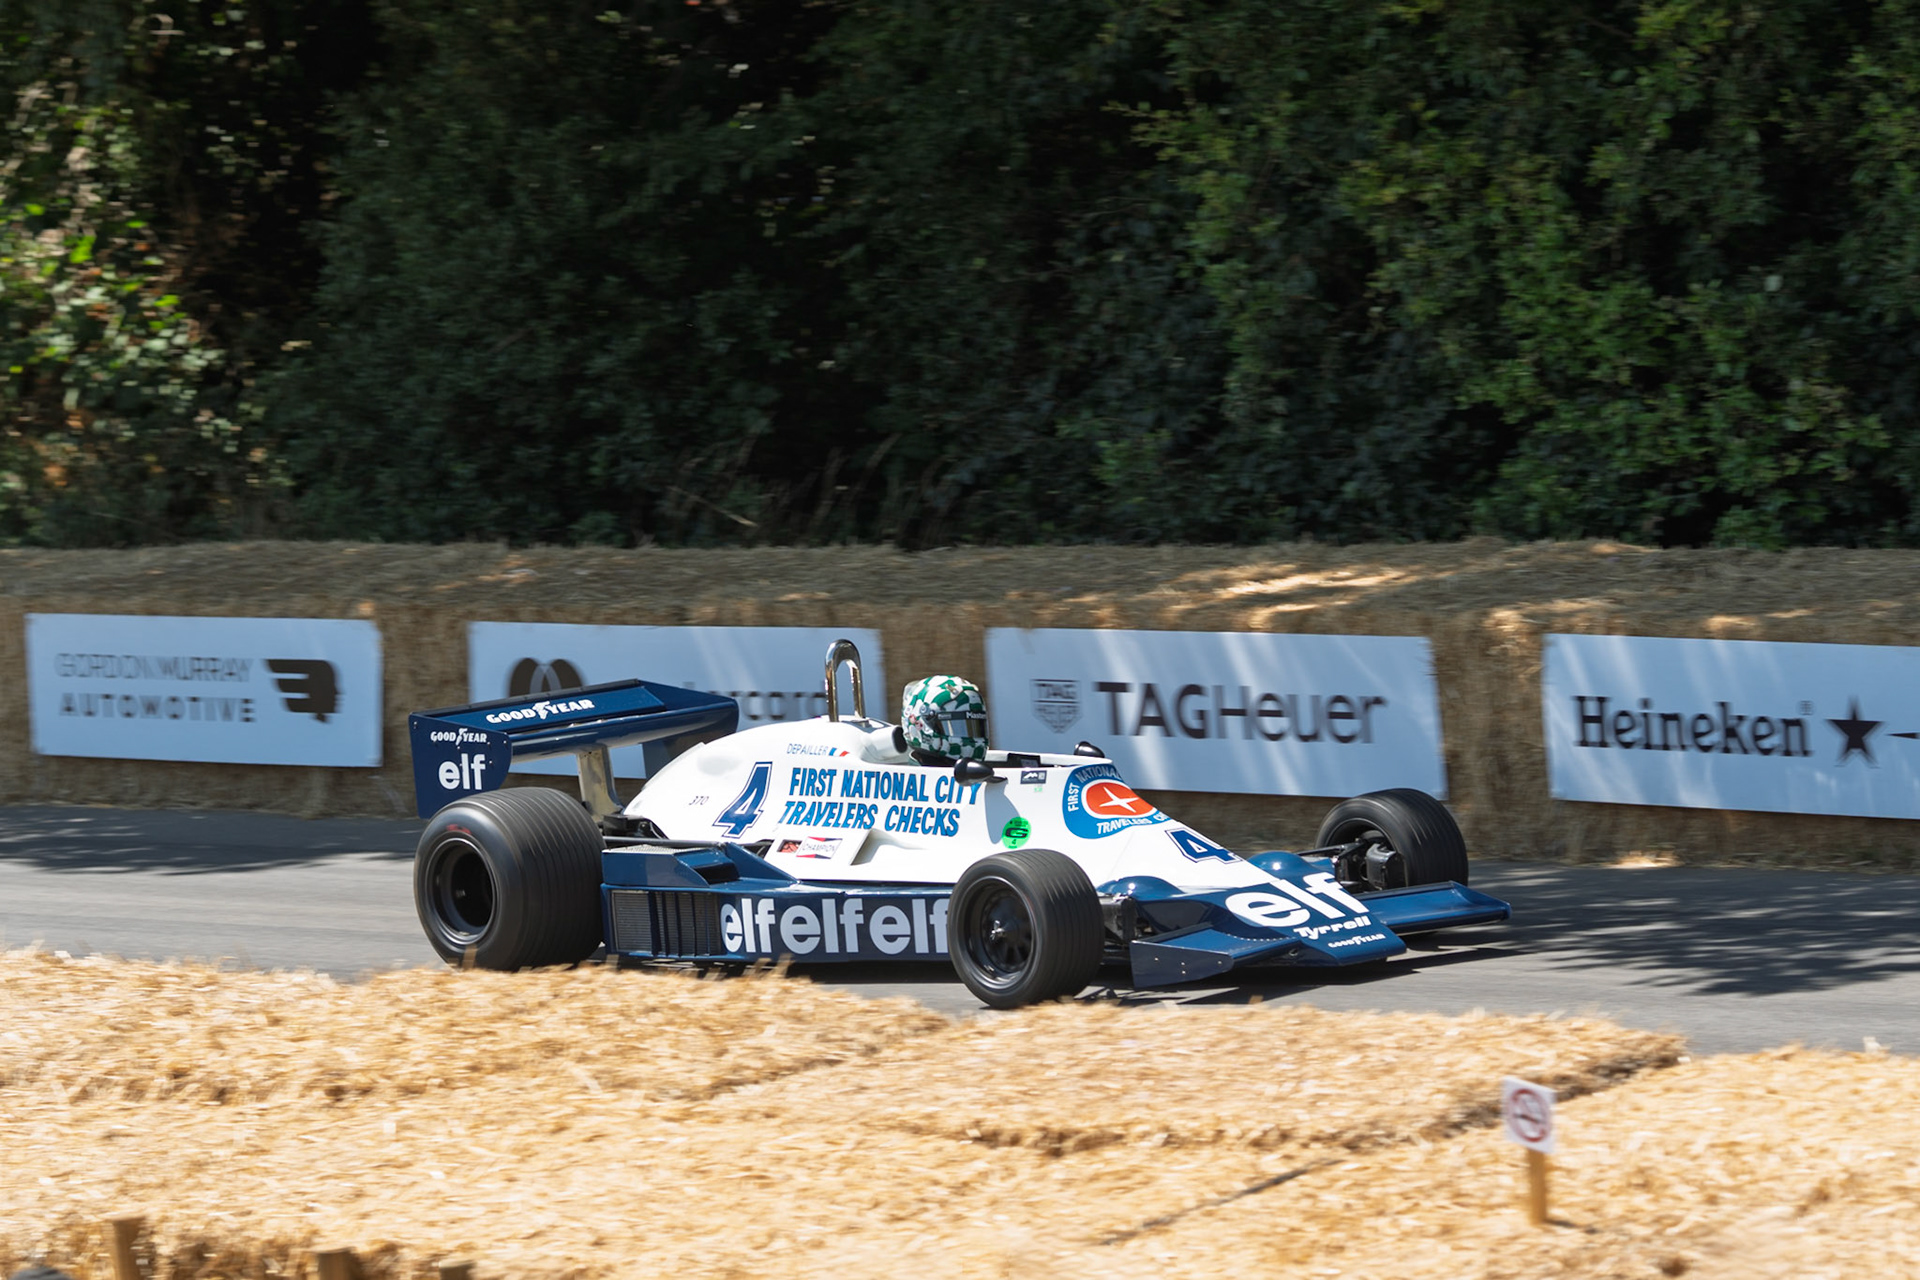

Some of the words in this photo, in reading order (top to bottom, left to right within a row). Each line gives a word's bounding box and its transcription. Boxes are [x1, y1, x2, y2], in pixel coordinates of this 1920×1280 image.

[59, 692, 257, 723] AUTOMOTIVE
[1572, 694, 1812, 758] Heineken
[786, 743, 828, 756] DEPAILLER
[438, 752, 486, 790] elf
[789, 767, 837, 797] FIRST
[840, 769, 929, 803] NATIONAL
[711, 760, 774, 840] 4
[1067, 783, 1080, 813] FIRST
[778, 800, 878, 831] TRAVELERS
[884, 804, 960, 837] CHECKS
[1164, 826, 1244, 865] 4
[1225, 871, 1370, 928] elf
[720, 897, 776, 953] elf
[780, 898, 864, 955] elf
[1293, 915, 1372, 940] Tyrrell
